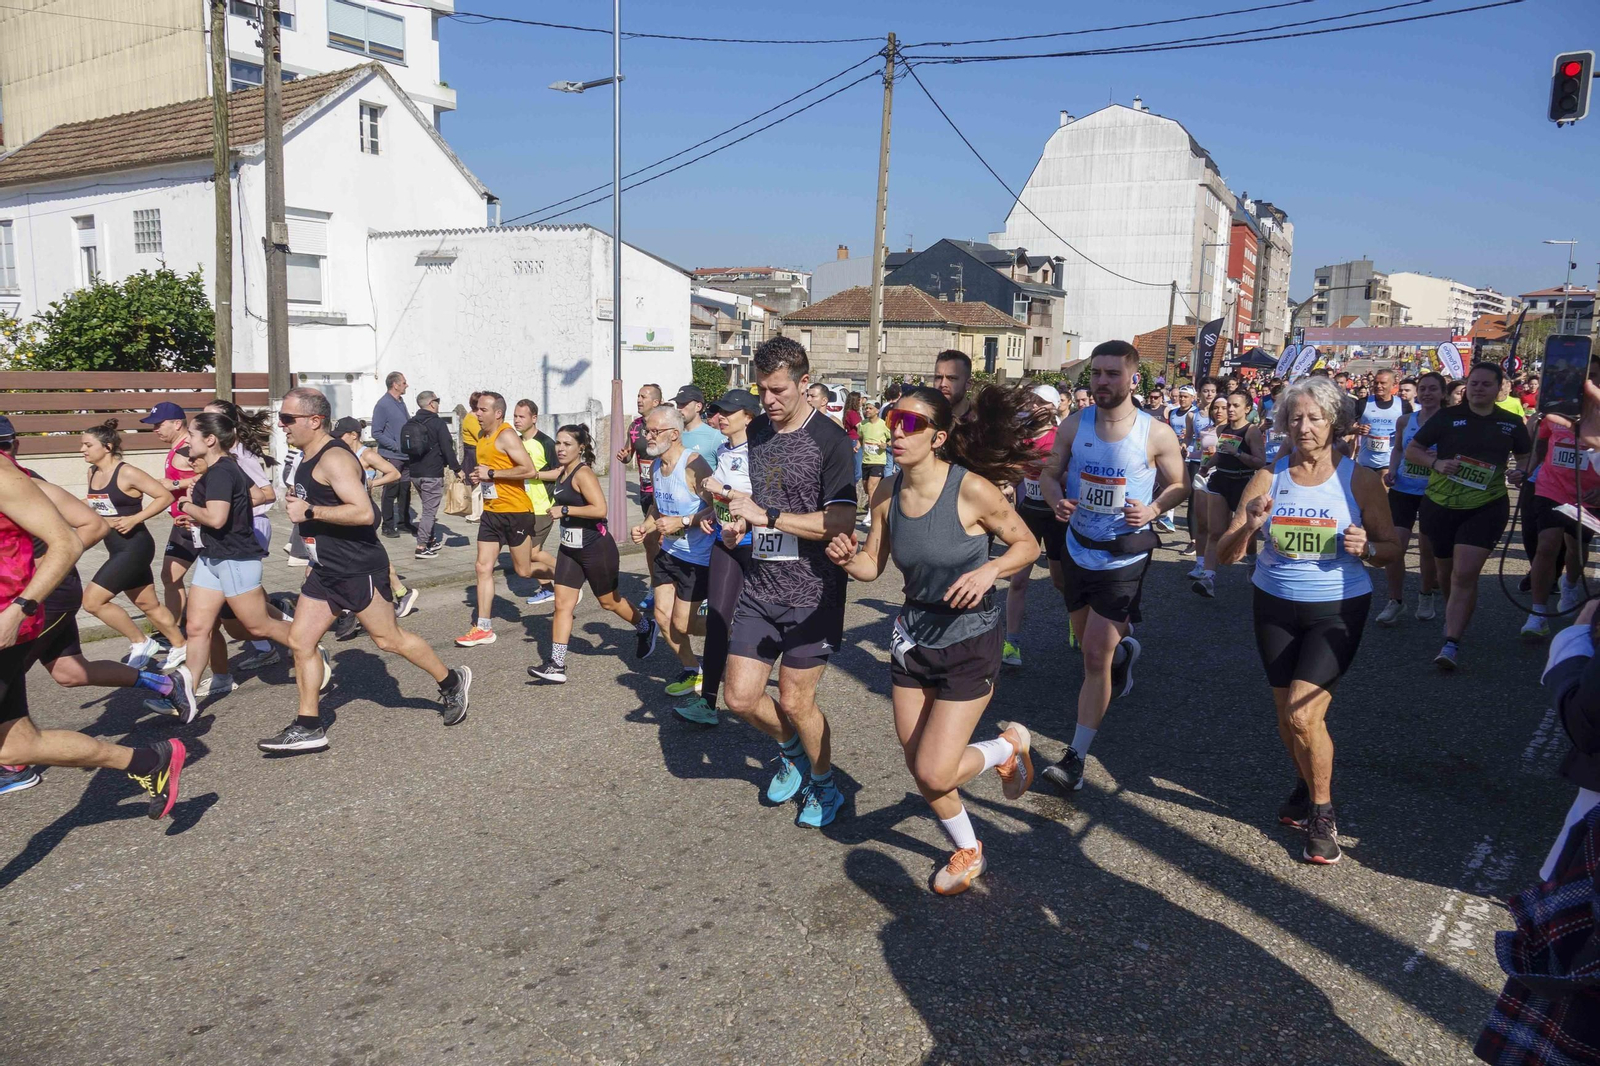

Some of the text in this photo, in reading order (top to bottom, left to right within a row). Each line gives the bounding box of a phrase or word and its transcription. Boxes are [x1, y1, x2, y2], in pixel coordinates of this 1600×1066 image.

[1371, 440, 1385, 449] 827
[1454, 464, 1488, 484] 2055
[1086, 487, 1114, 507] 480
[758, 533, 783, 552] 257
[1285, 531, 1321, 553] 2161
